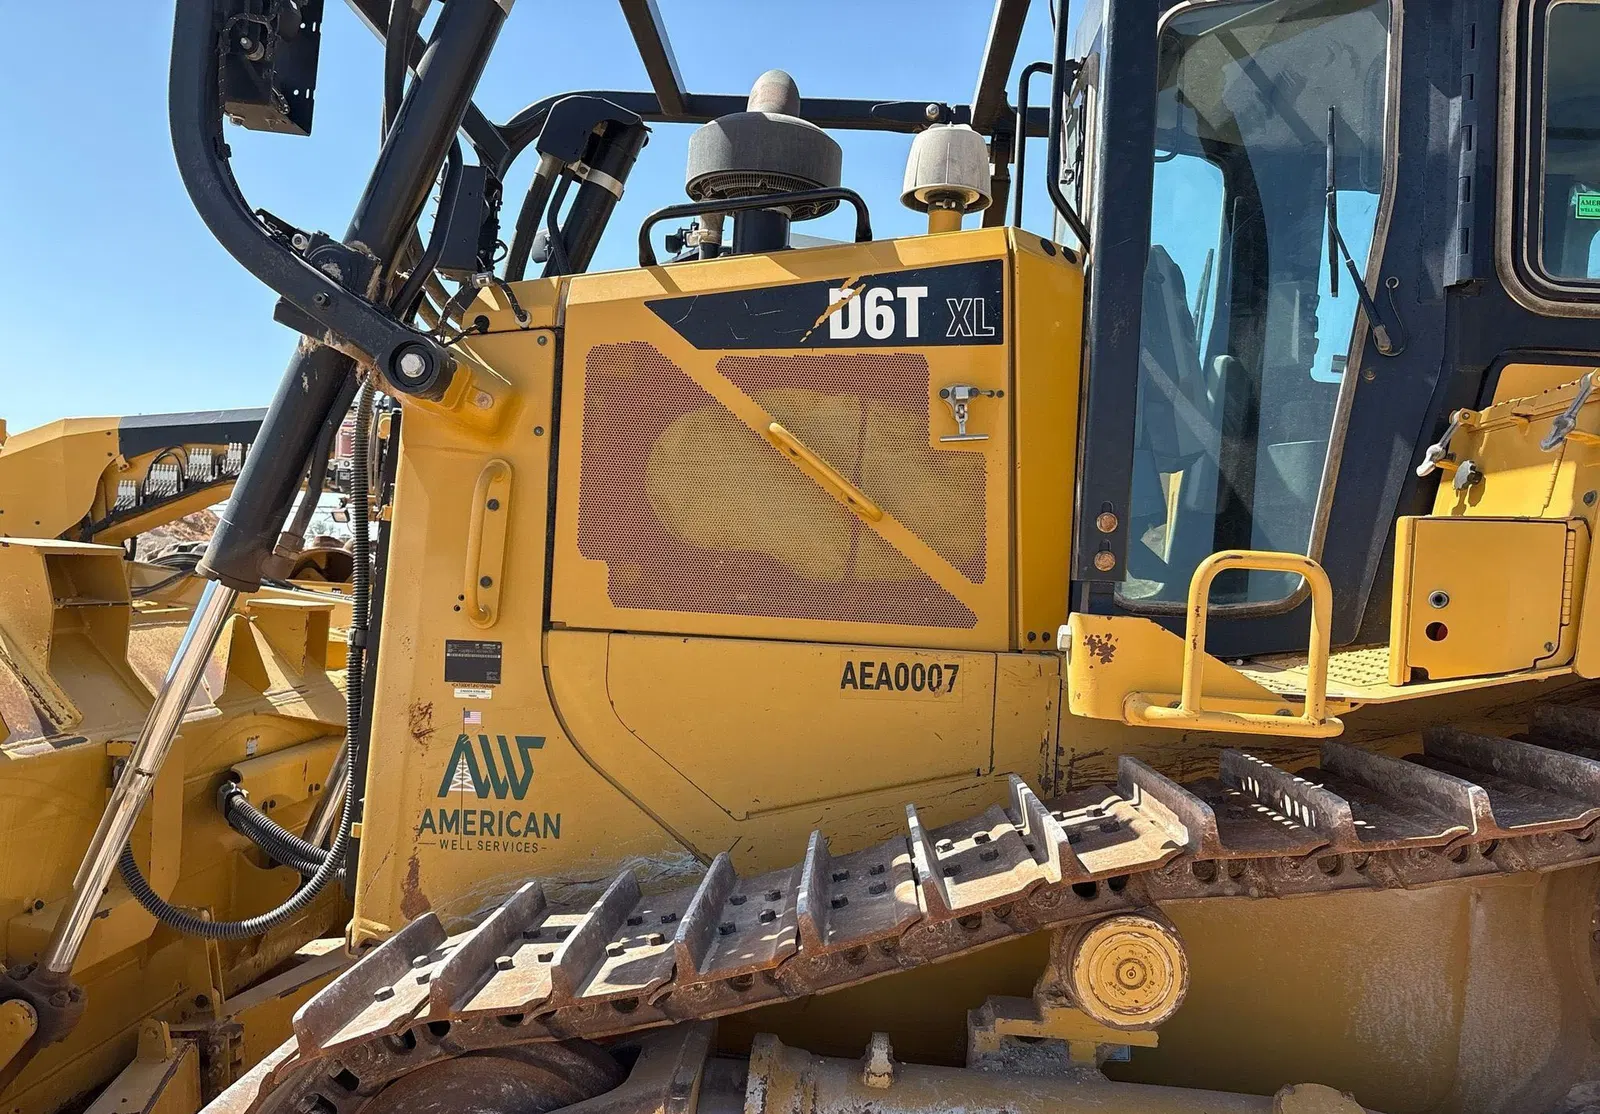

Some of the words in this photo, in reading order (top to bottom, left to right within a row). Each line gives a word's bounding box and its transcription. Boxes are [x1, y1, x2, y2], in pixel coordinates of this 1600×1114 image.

[828, 286, 929, 340] D6T
[945, 297, 996, 338] XL
[840, 661, 960, 693] AEA0007
[419, 808, 561, 839] AMERICAN
[439, 839, 473, 851] WELL
[477, 840, 540, 853] SERVICES
